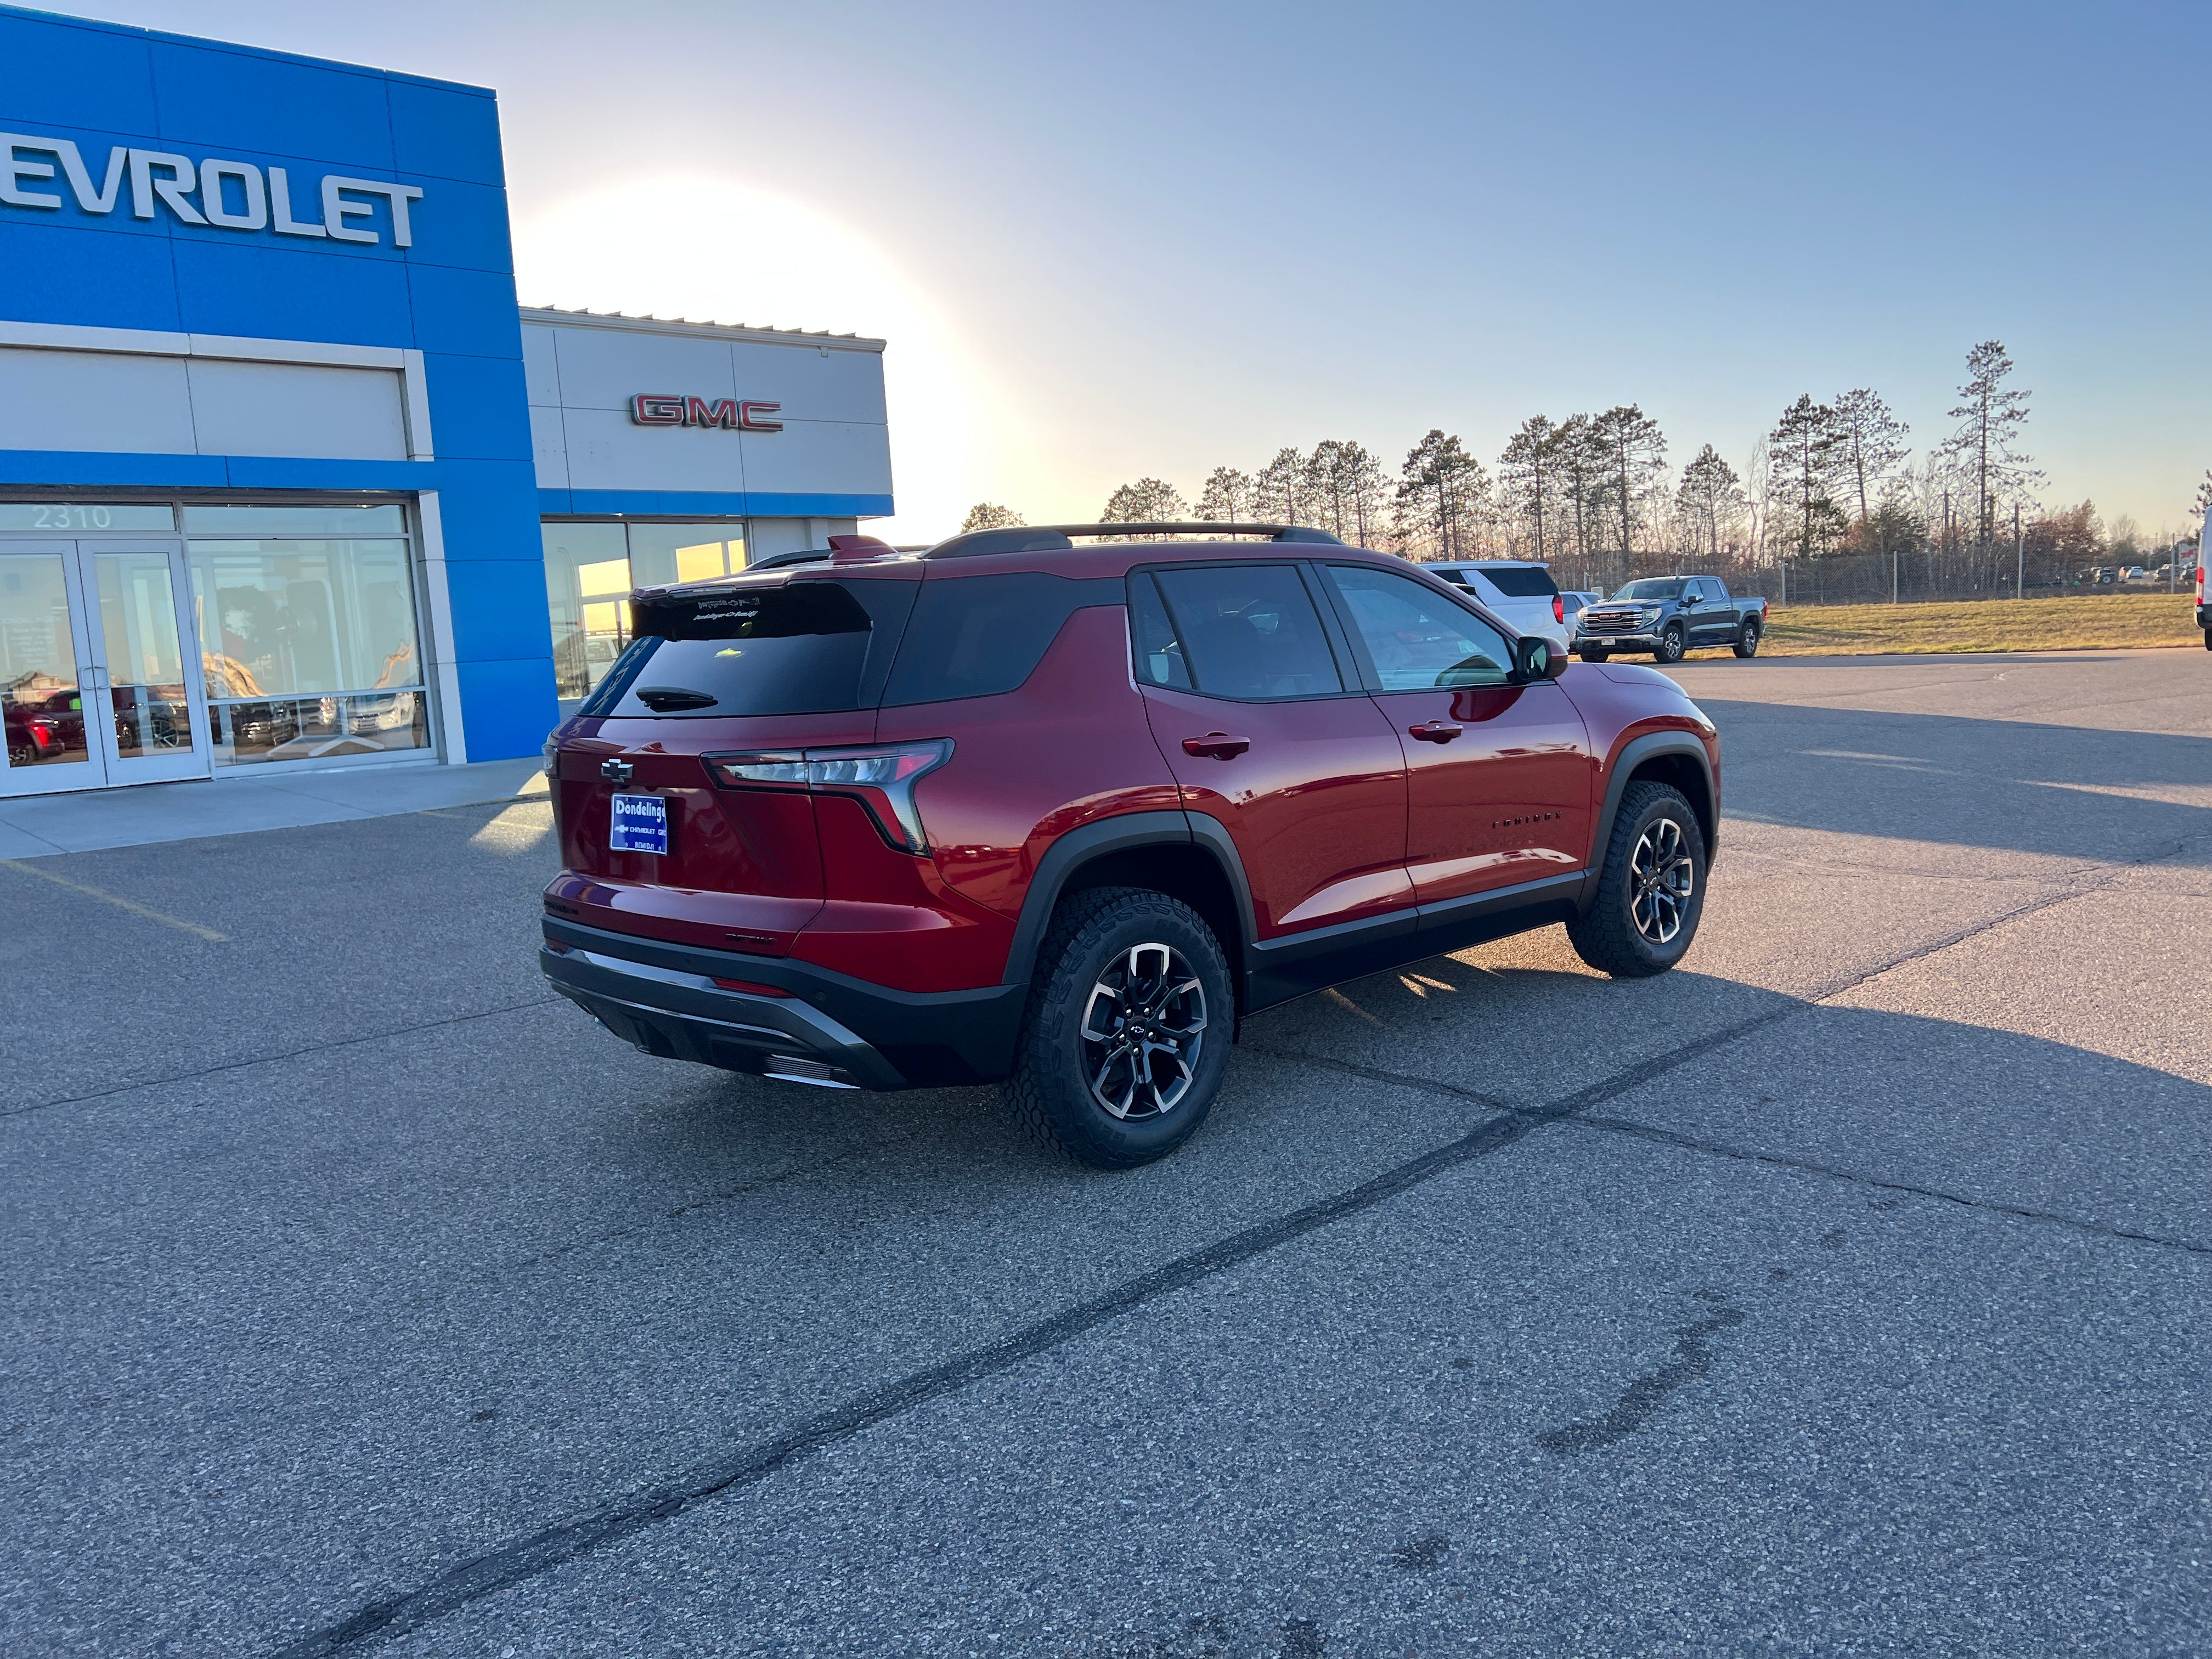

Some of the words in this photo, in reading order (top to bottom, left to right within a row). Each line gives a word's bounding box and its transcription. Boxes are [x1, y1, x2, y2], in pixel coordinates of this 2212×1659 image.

[0, 132, 424, 247] EVROLET
[630, 393, 783, 431] GMC
[32, 506, 110, 528] 2310
[630, 826, 655, 834] CHEVROLET
[635, 841, 654, 850] BEMIDJI
